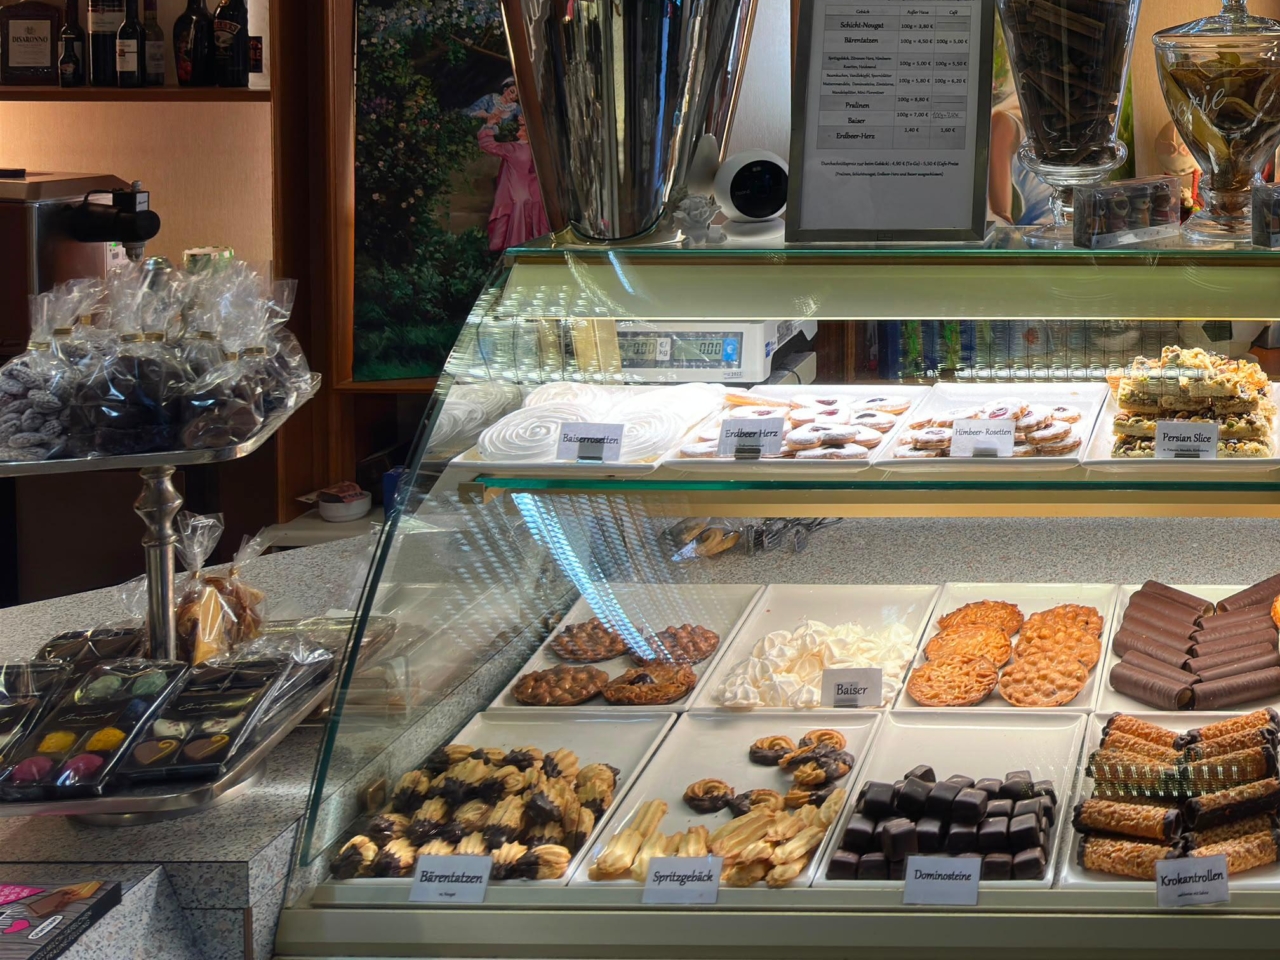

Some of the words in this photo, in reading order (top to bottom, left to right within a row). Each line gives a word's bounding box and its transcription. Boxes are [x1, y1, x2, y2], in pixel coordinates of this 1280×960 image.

[840, 21, 884, 30] Schicht-Nougat
[12, 35, 48, 43] DISARONNO
[844, 36, 879, 44] Bärentatzen
[845, 101, 870, 109] Pralinen
[658, 348, 668, 357] kg
[700, 342, 722, 355] 0.00
[562, 432, 619, 445] Baiserrosetten
[724, 428, 758, 439] Erdbeer
[759, 428, 779, 439] Herz
[954, 427, 983, 437] Himbeer-
[985, 427, 1012, 436] Rosetten
[1162, 431, 1193, 443] Persian
[1193, 432, 1212, 444] Slice
[836, 683, 868, 696] Baiser
[419, 869, 483, 885] Bärentatzen
[652, 870, 714, 887] Spritzgebäck
[914, 869, 972, 882] Dominosteine
[1160, 870, 1224, 887] Krokantrollen
